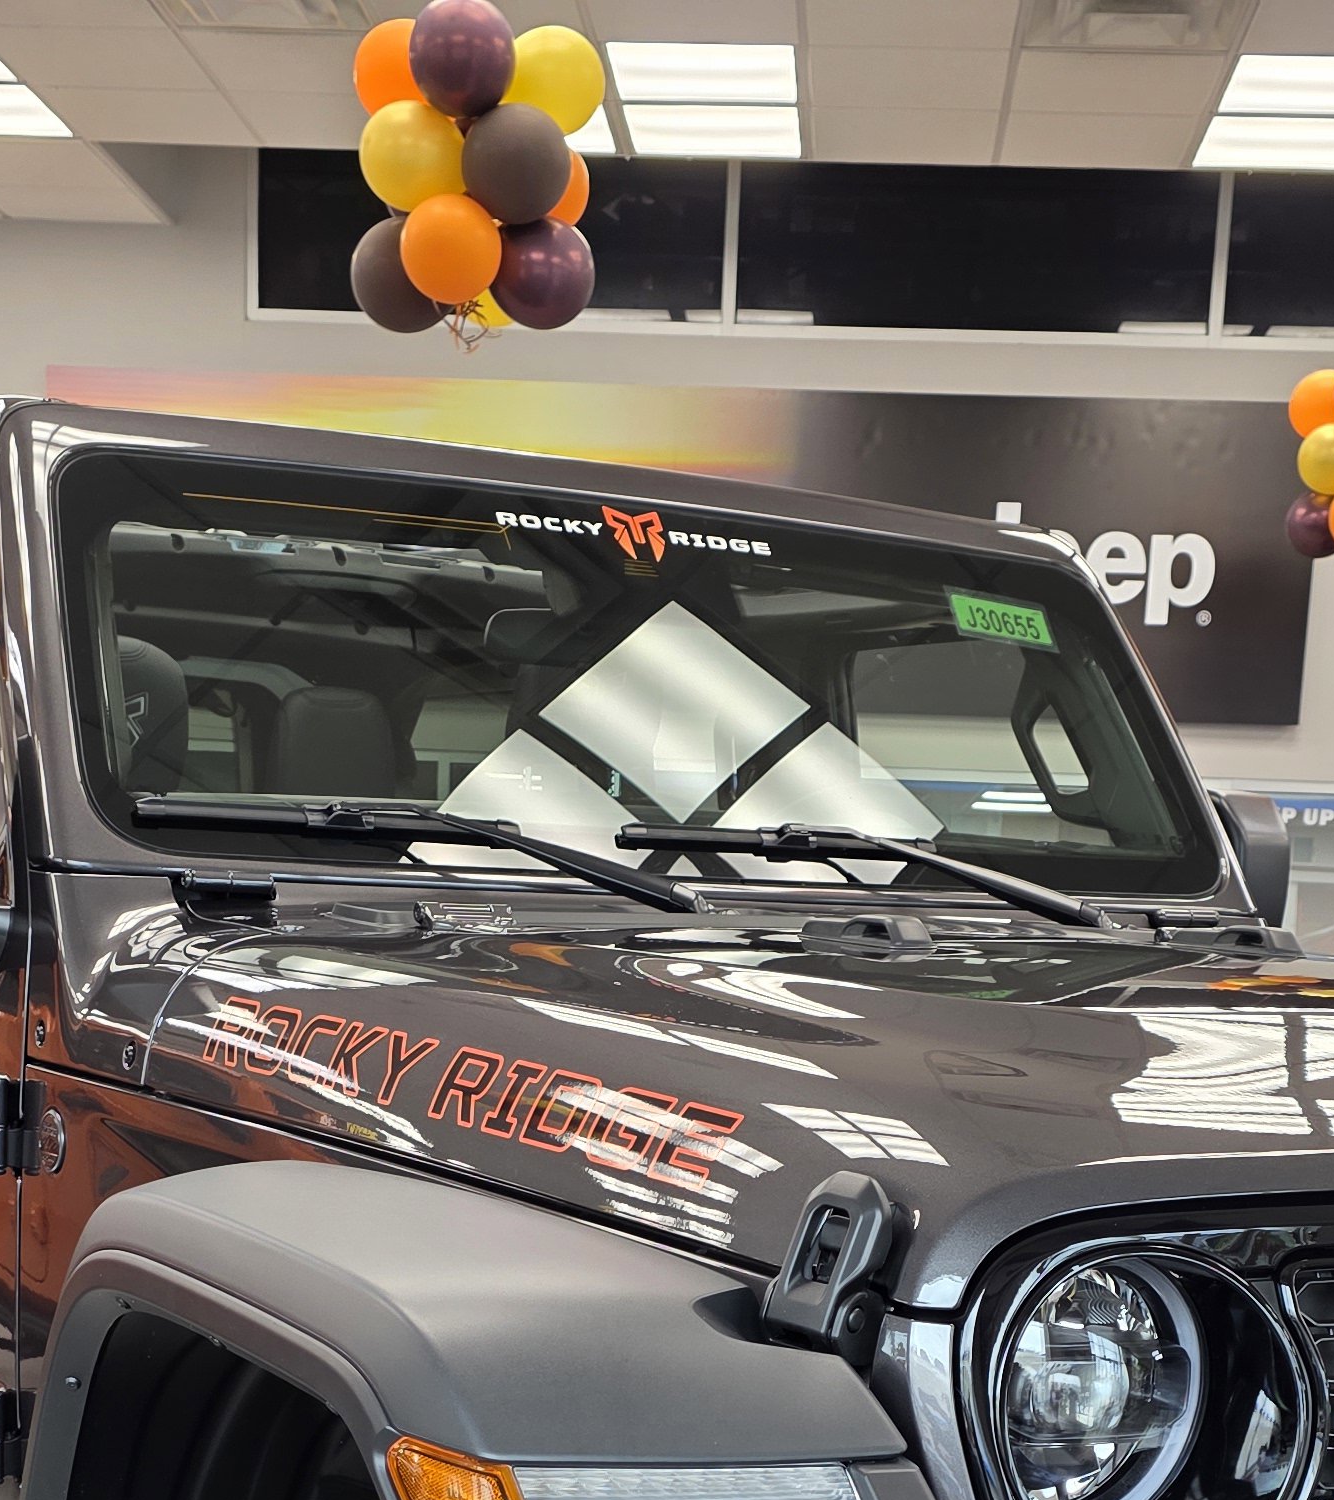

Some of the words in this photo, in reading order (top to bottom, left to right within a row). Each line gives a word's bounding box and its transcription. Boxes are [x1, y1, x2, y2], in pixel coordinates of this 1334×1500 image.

[495, 511, 602, 536] ROCKY
[668, 531, 772, 556] RIDGE
[967, 604, 1041, 640] J30655
[1303, 806, 1334, 827] UP
[202, 996, 440, 1105] ROCKY
[428, 1046, 745, 1190] RIDGE
